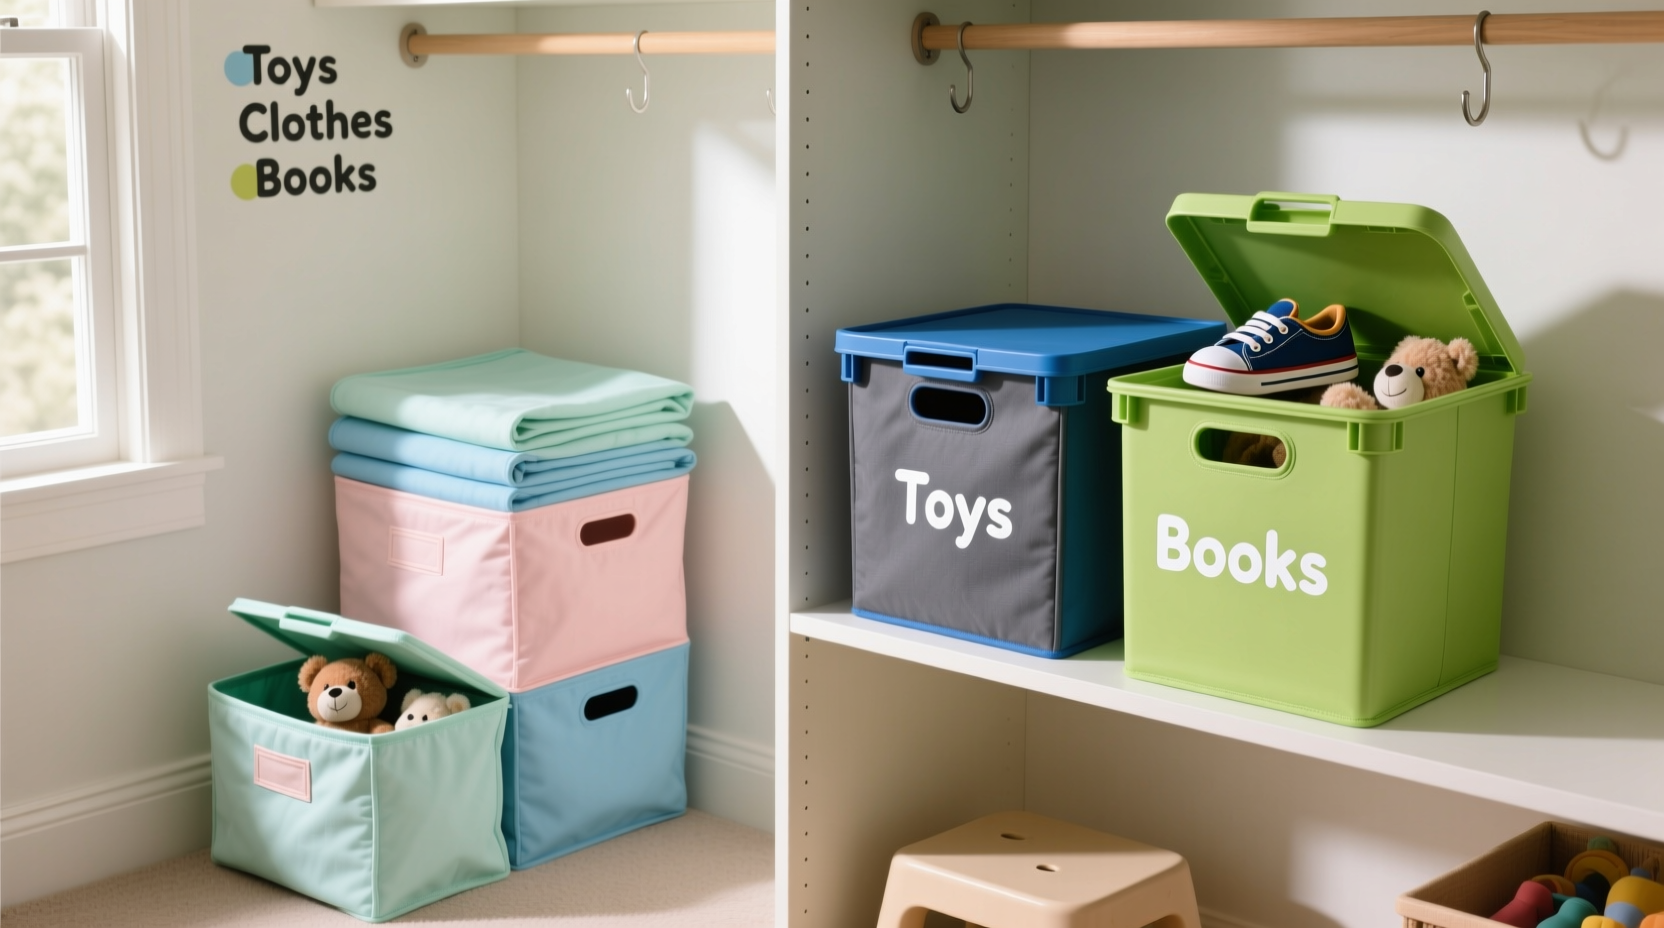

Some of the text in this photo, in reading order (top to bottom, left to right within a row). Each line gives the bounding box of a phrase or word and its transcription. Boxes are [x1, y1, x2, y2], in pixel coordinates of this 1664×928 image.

[242, 44, 338, 97] Toys
[239, 99, 393, 143] Clothes
[256, 153, 377, 198] Books
[894, 468, 1013, 549] Toys
[1156, 512, 1329, 597] Books
